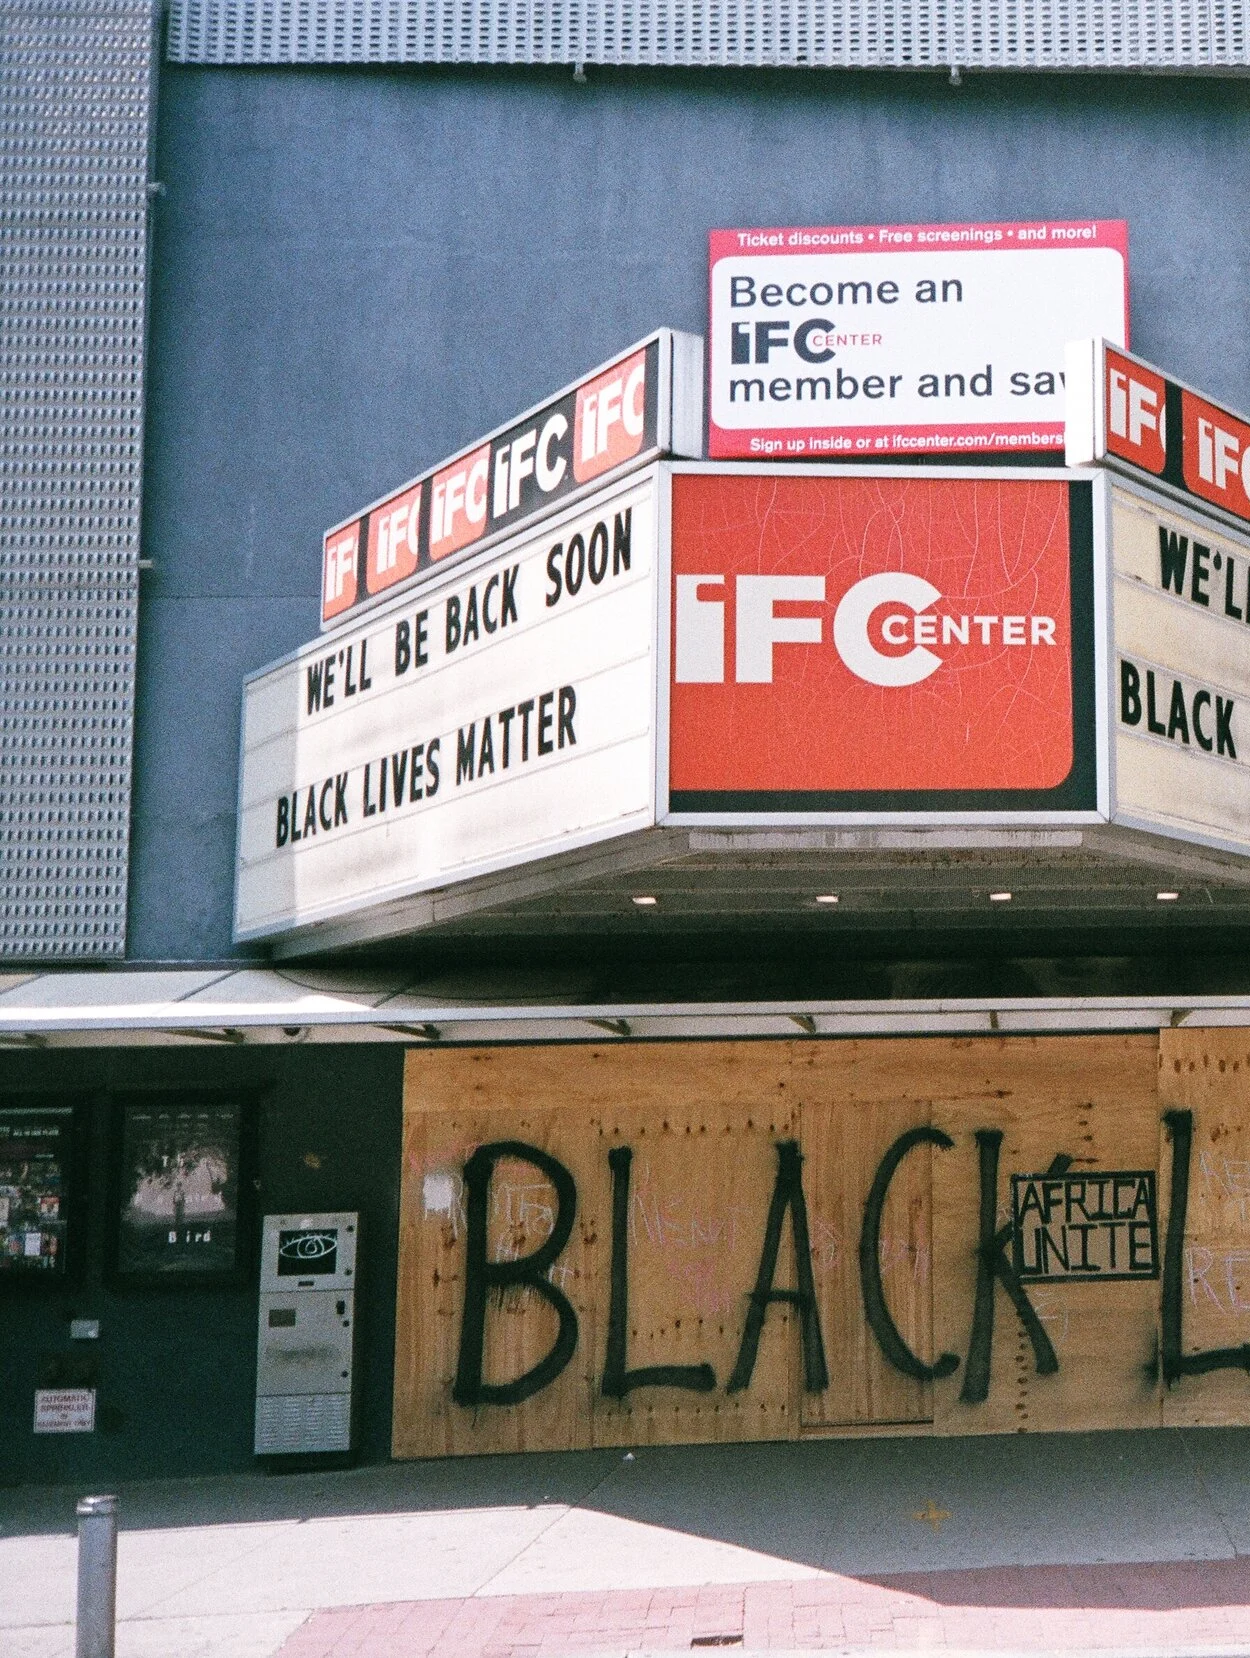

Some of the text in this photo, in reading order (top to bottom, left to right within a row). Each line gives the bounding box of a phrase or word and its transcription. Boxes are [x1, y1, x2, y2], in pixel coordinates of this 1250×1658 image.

[738, 225, 1097, 248] Ticket discounts Free screenings and more!
[730, 275, 963, 308] Become an
[812, 333, 883, 348] CENTER
[730, 368, 903, 402] member
[918, 364, 992, 398] and
[750, 432, 1066, 454] Sign up inside or at ifccenter.com/members
[305, 506, 632, 716] WE'LL BE BACK SOON
[881, 614, 1057, 645] CENTER
[1120, 658, 1238, 762] BLACK
[276, 683, 578, 849] BLACK LIVES MATTER
[1018, 1175, 1156, 1227] AFRICA
[451, 1125, 1071, 1408] BLACK
[1021, 1220, 1155, 1272] UNITE
